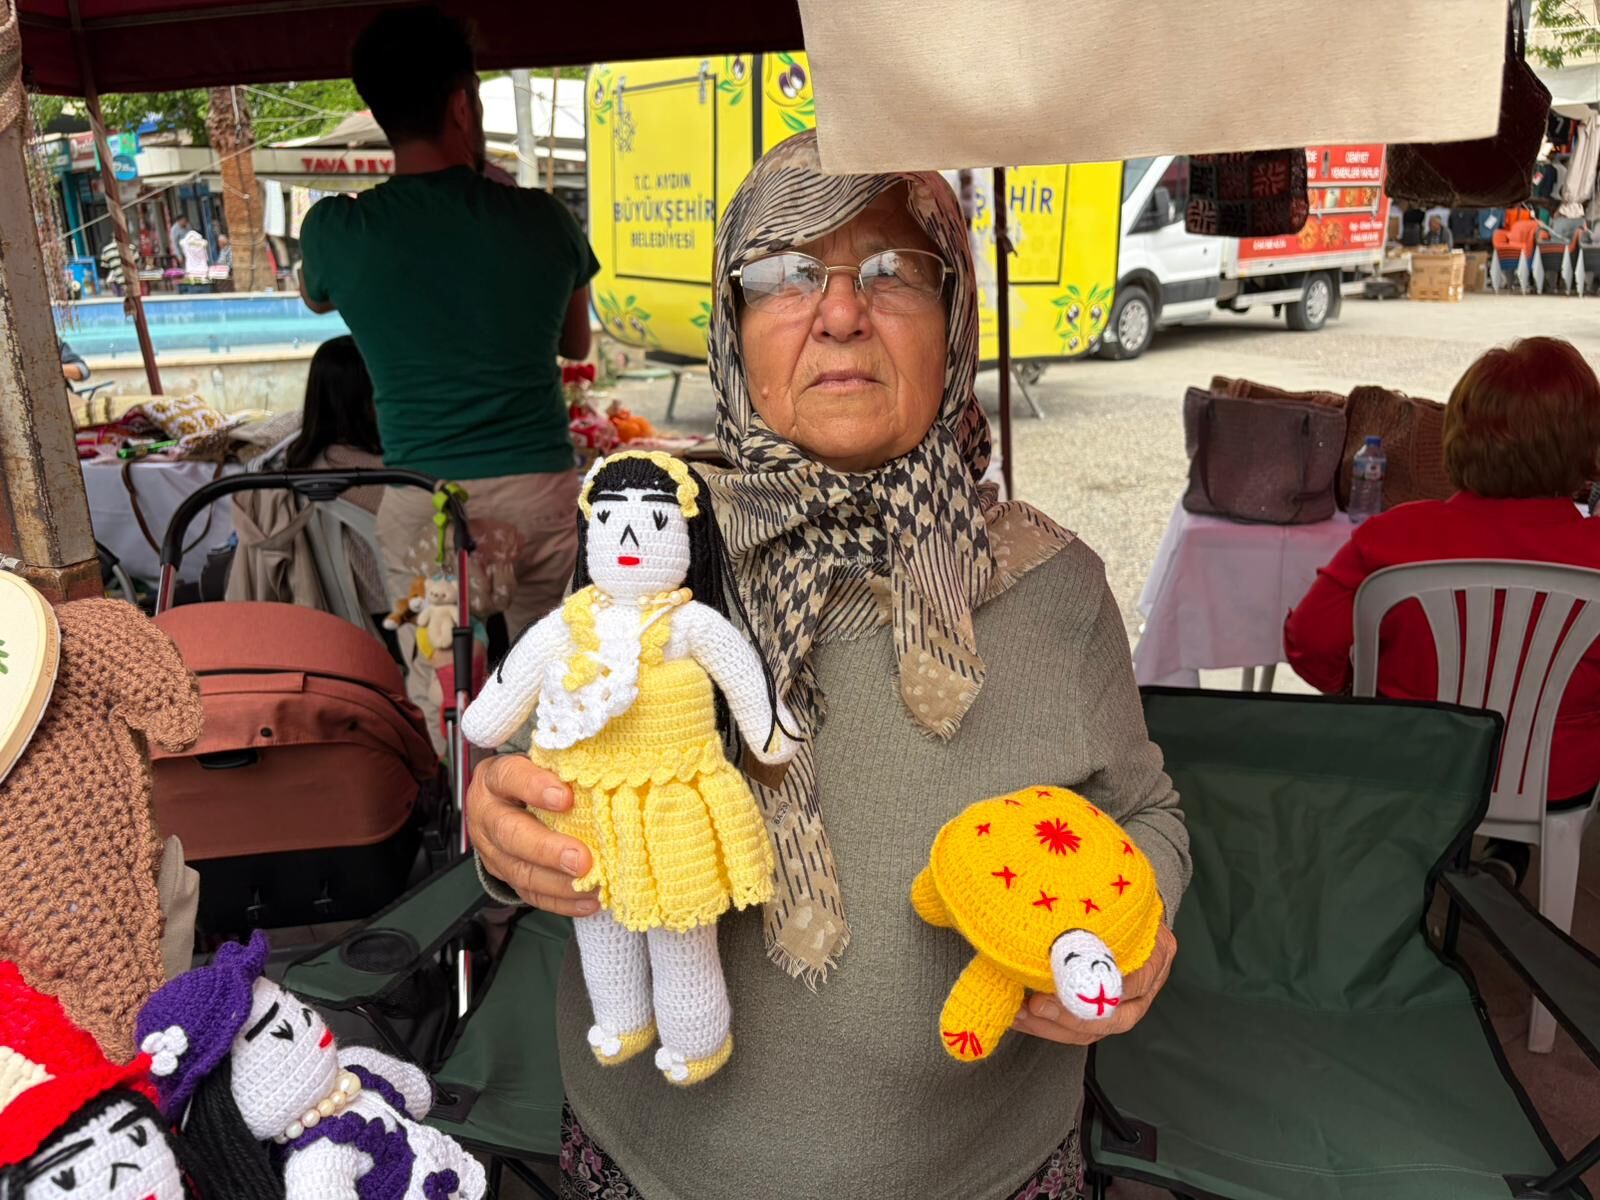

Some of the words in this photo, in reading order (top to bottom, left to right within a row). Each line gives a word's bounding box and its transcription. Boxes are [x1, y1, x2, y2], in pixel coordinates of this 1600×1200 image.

[301, 156, 349, 173] TAVA
[656, 172, 692, 189] AYDIN
[613, 193, 716, 228] BÜYÜKŞEHİR
[630, 229, 696, 249] BELEDİYESİ
